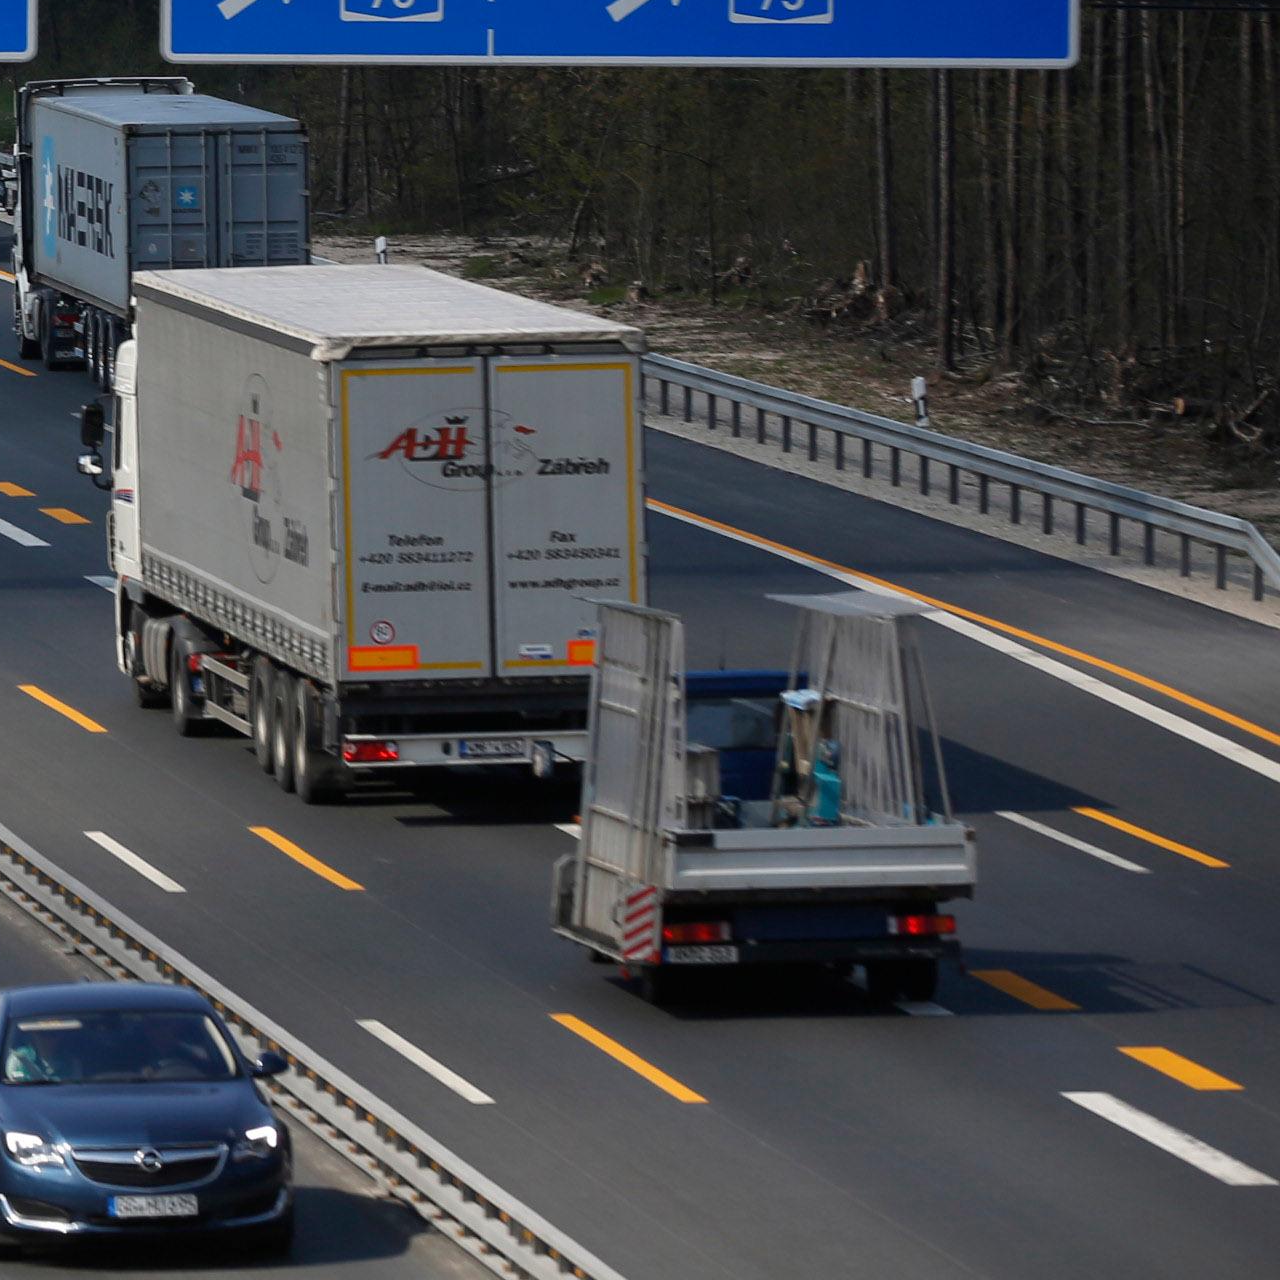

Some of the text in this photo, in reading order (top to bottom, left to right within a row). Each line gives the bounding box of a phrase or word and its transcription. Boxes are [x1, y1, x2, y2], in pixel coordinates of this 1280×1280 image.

[57, 164, 115, 259] MAERSK
[388, 534, 445, 547] Telefon
[549, 530, 576, 543] Fax
